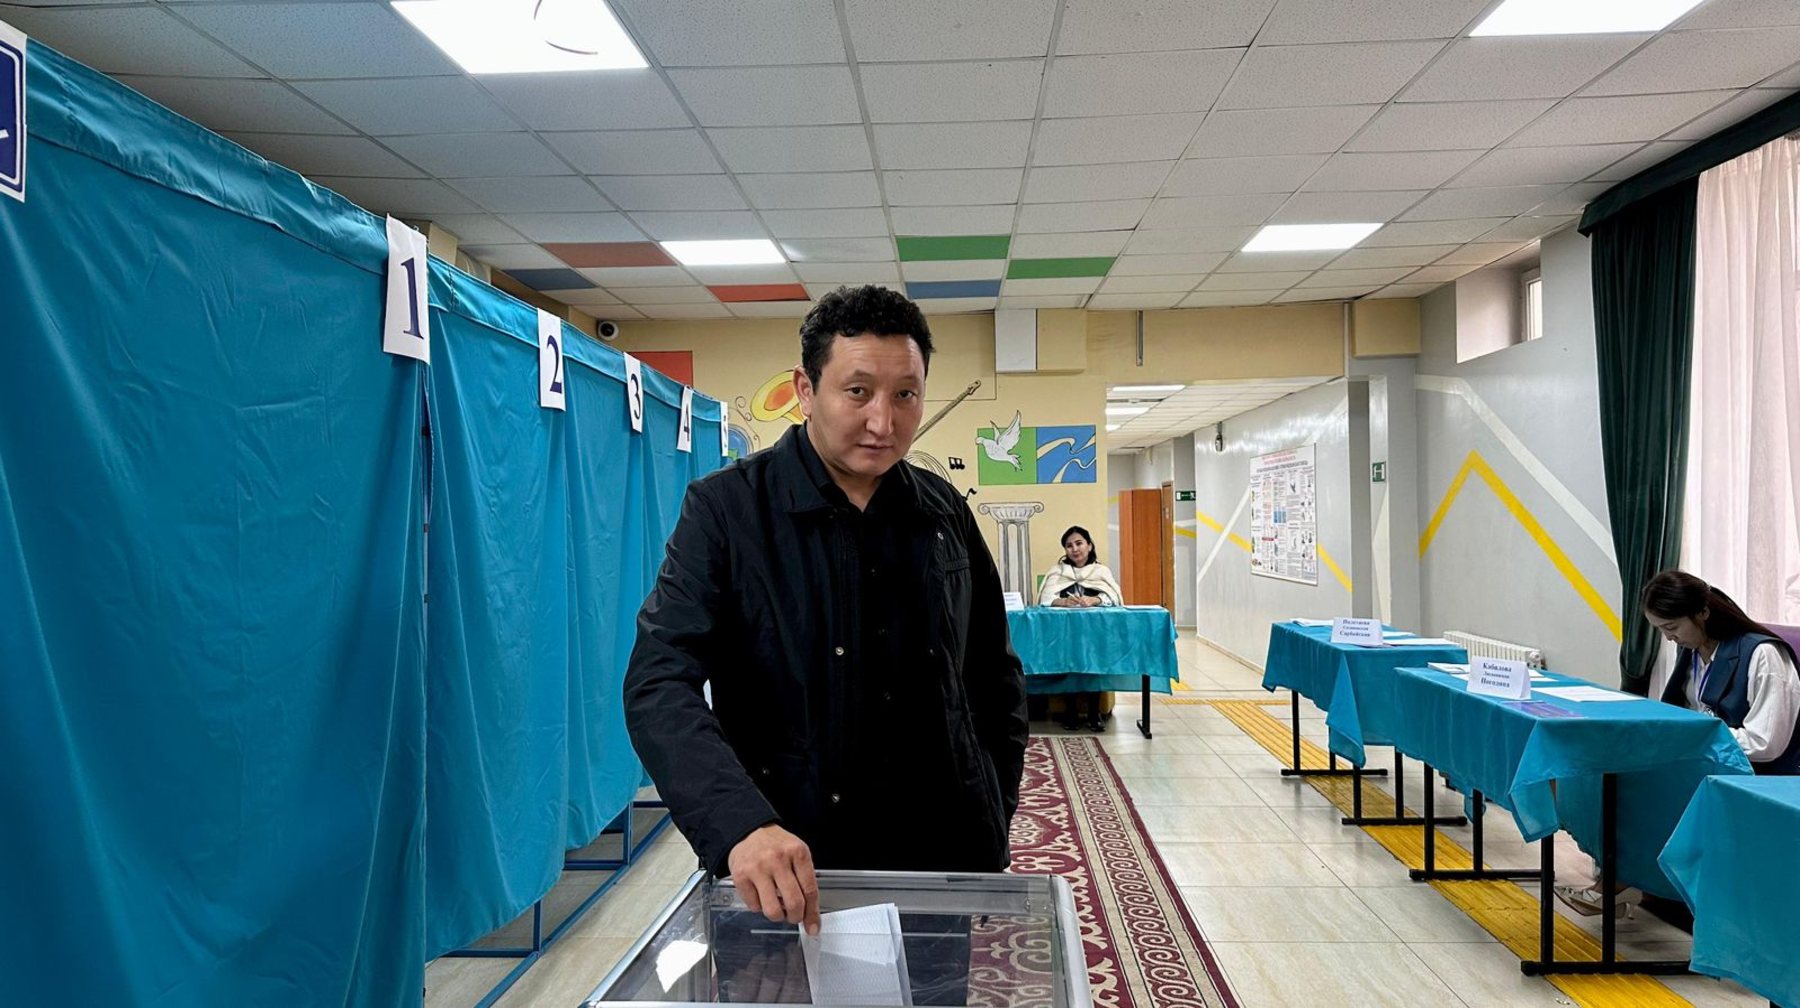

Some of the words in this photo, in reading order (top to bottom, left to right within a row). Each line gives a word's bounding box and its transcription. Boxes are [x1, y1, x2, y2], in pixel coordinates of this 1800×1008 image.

[401, 258, 424, 339] 1
[547, 335, 562, 394] 2
[631, 373, 641, 420] 3
[683, 403, 690, 442] 4
